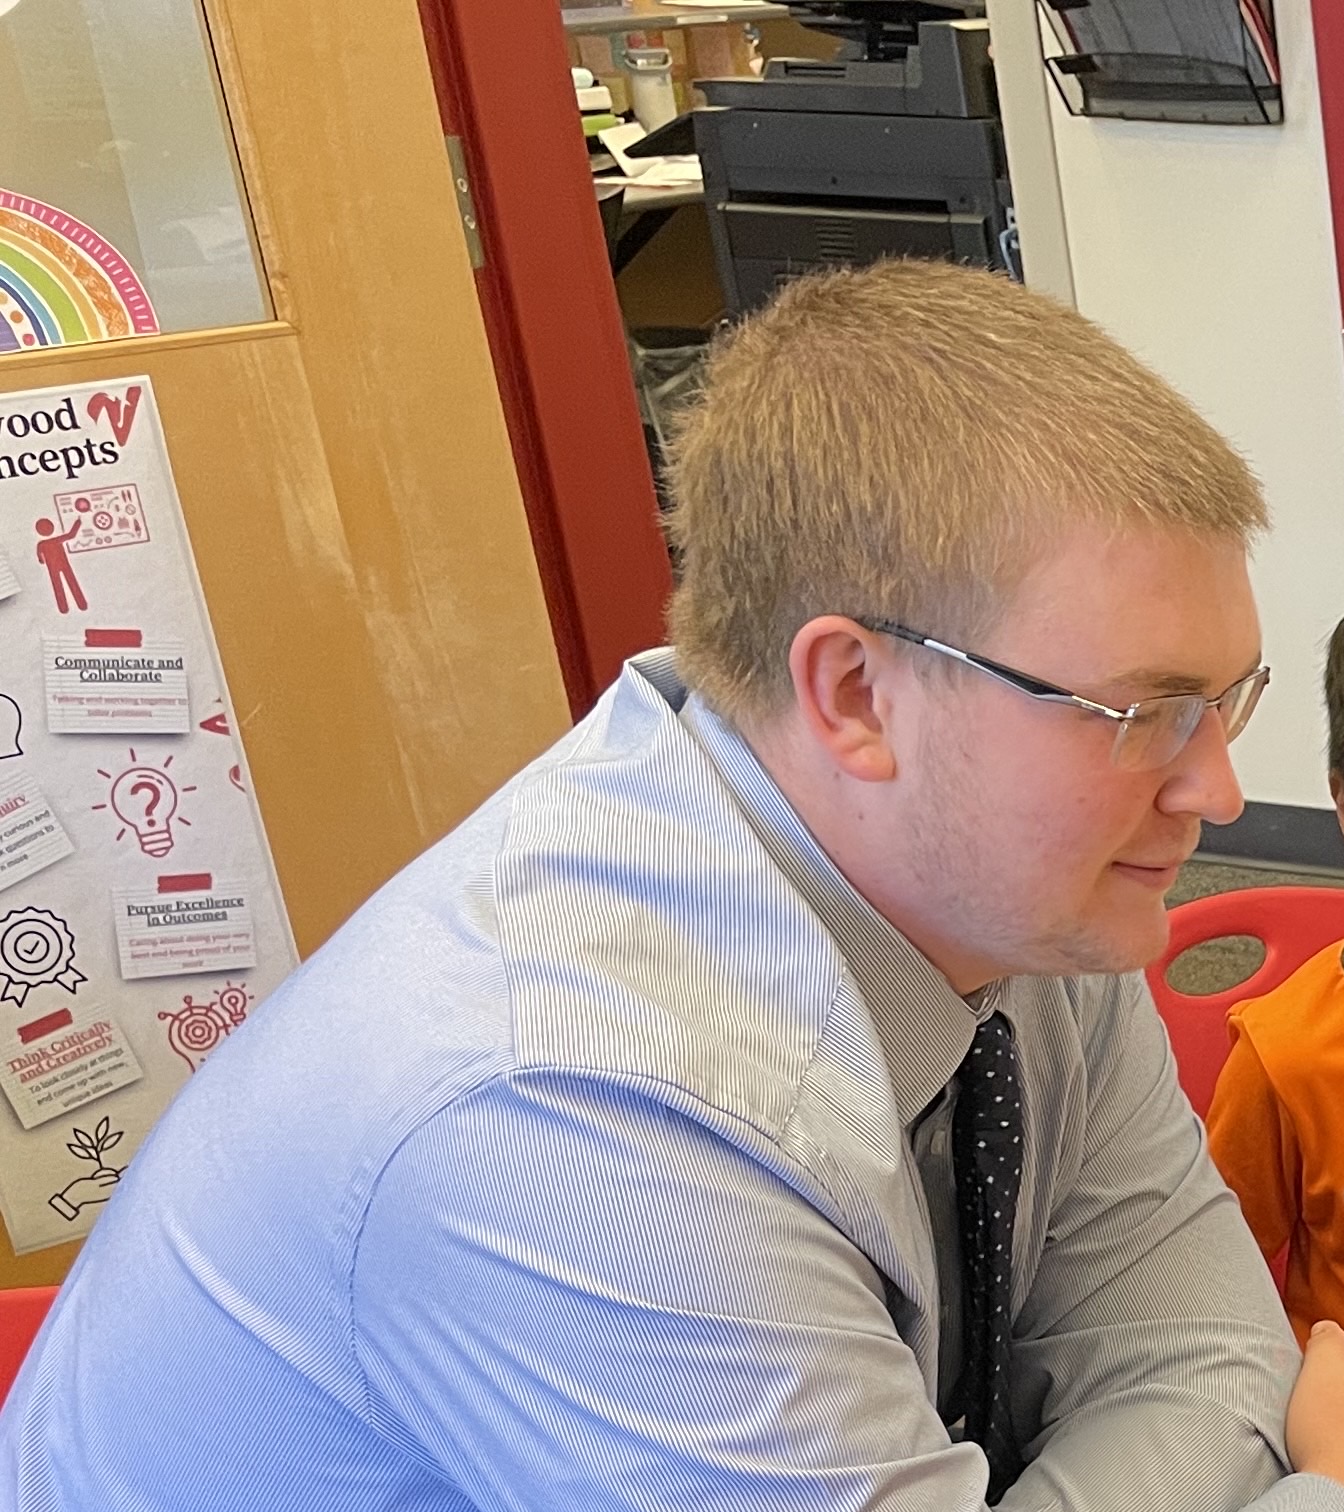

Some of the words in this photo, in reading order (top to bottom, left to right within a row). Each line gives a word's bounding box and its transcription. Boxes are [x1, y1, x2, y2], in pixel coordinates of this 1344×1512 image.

[0, 397, 81, 438] ood
[55, 656, 154, 669] Communicate
[158, 657, 183, 669] and
[80, 671, 162, 682] Collaborate
[127, 904, 173, 916] Pursue
[176, 897, 245, 911] Excellence
[163, 910, 228, 925] Outcomes
[7, 1046, 50, 1074] Think
[51, 1020, 112, 1055] Critically
[20, 1065, 46, 1083] and
[46, 1034, 113, 1070] Creatively
